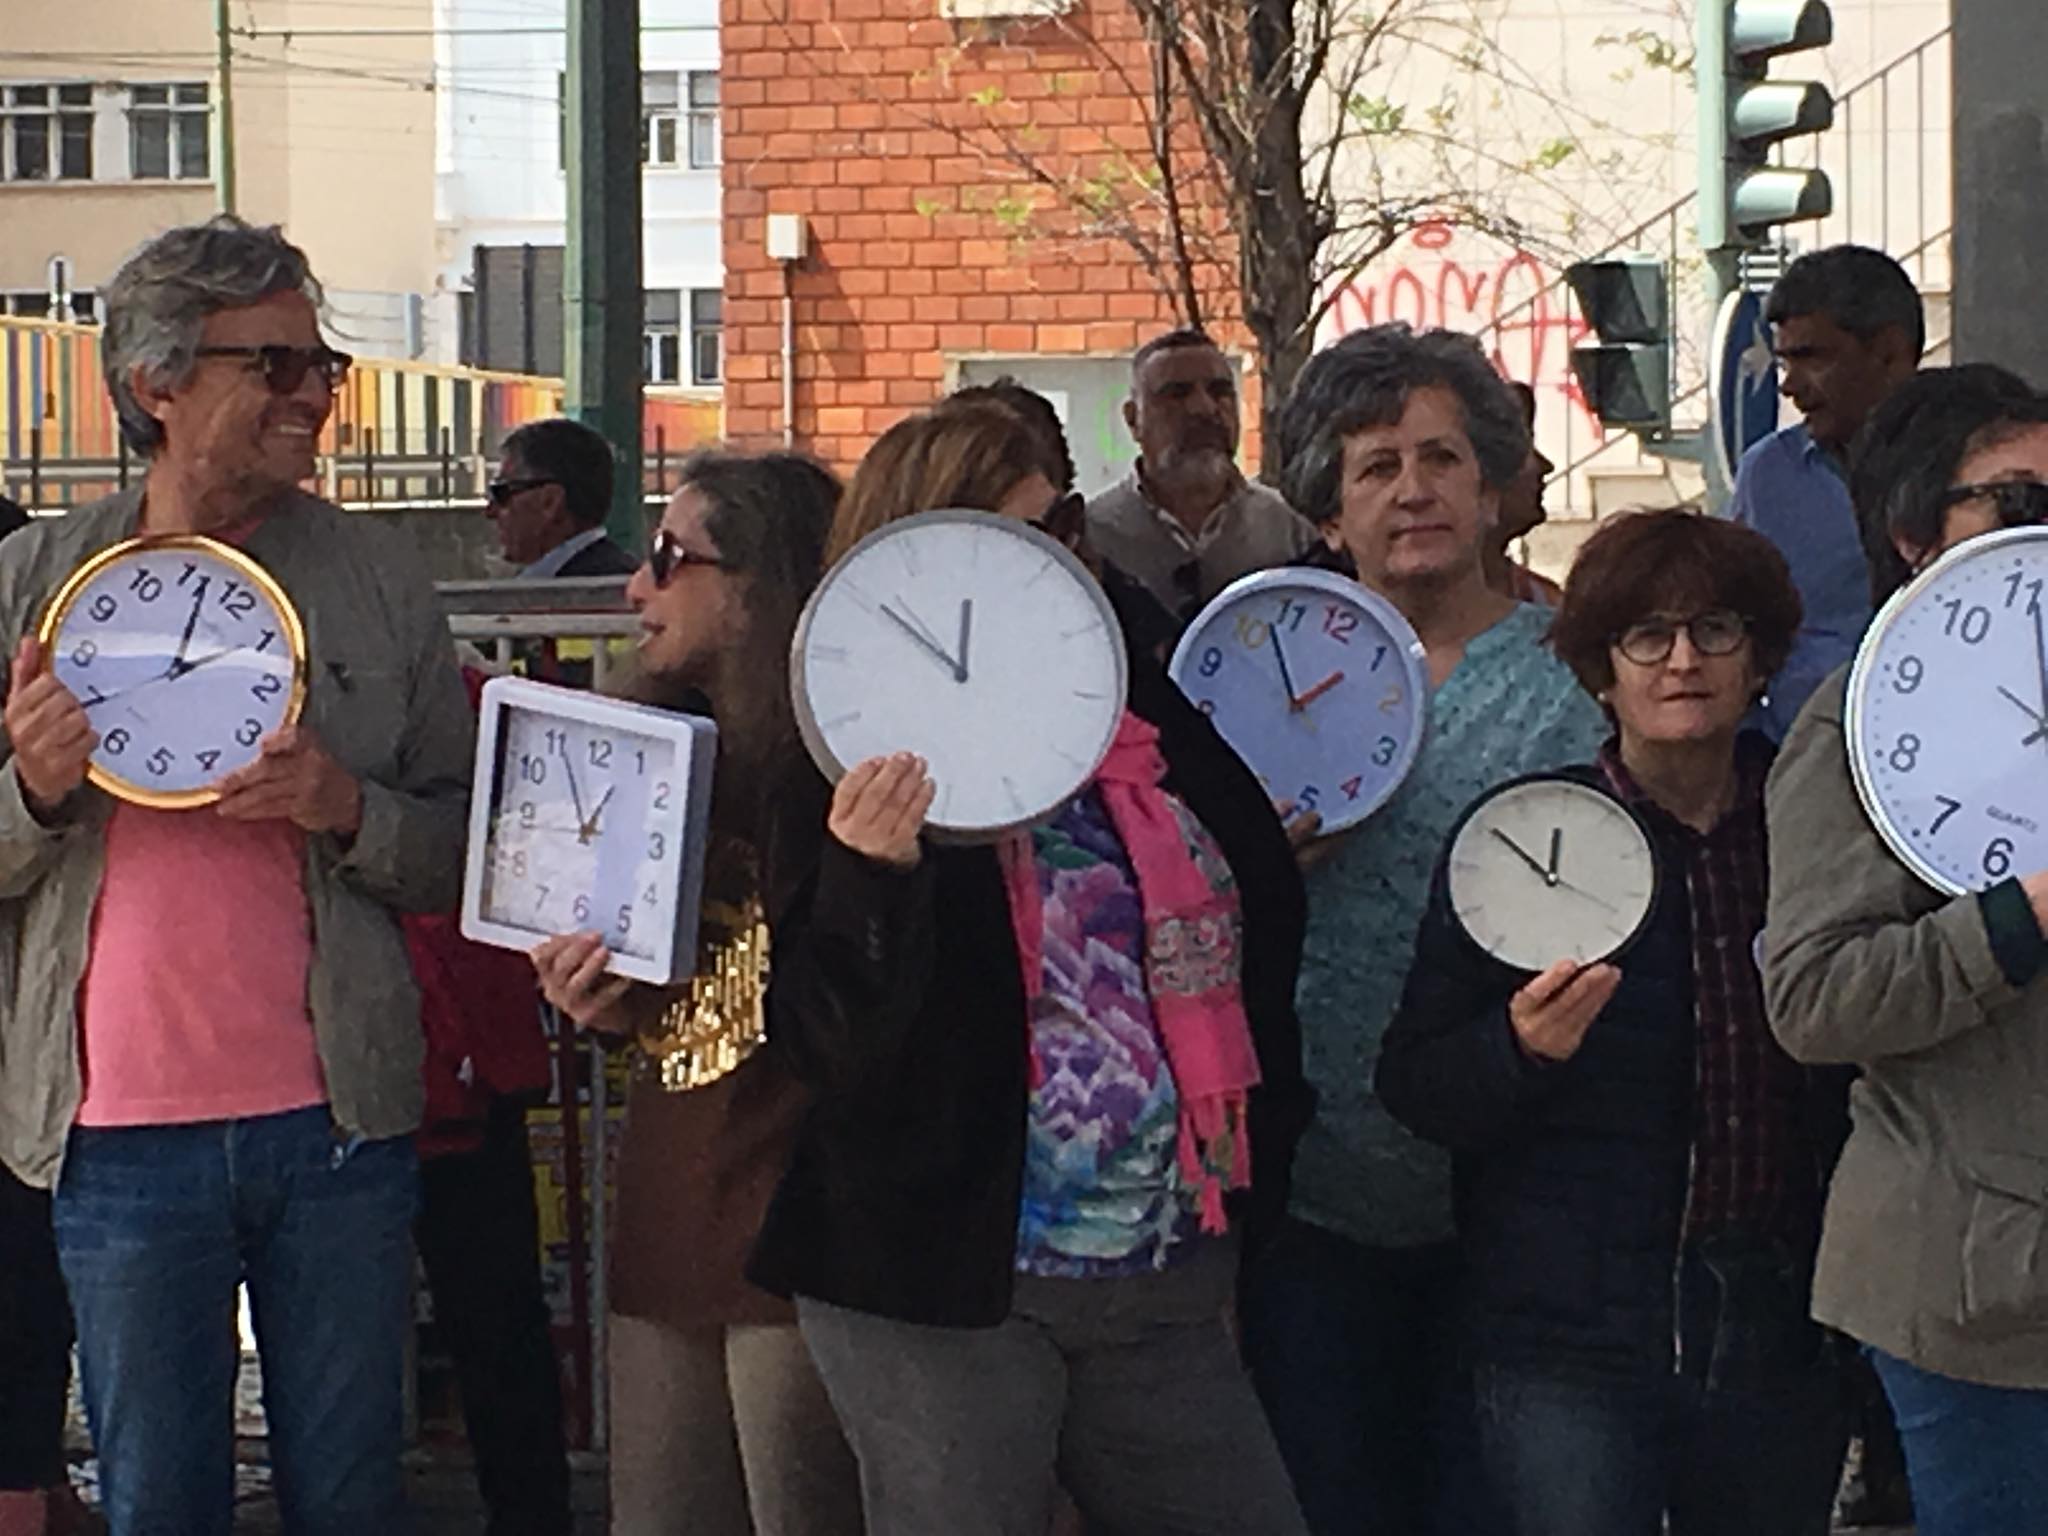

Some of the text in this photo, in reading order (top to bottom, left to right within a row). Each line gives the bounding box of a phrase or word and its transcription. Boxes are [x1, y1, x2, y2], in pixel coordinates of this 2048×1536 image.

[128, 567, 163, 602] 10
[176, 562, 212, 601] 11
[2003, 571, 2044, 616] 11
[88, 594, 118, 623] 9
[218, 580, 257, 621] 12
[1277, 597, 1307, 633] 11
[1233, 611, 1268, 650] 10
[1322, 604, 1359, 646] 12
[1943, 598, 1992, 644] 10
[70, 639, 98, 668] 8
[255, 629, 276, 653] 1
[1198, 646, 1222, 678] 9
[1371, 646, 1388, 672] 1
[251, 672, 282, 703] 2
[1892, 655, 1924, 694] 9
[81, 684, 105, 707] 7
[103, 728, 130, 756] 6
[234, 718, 263, 748] 3
[545, 728, 567, 757] 11
[146, 746, 176, 776] 5
[195, 749, 223, 772] 4
[588, 740, 613, 769] 12
[635, 750, 645, 776] 1
[1371, 735, 1397, 767] 3
[1888, 733, 1922, 773] 8
[520, 753, 546, 785] 10
[653, 782, 671, 811] 2
[1340, 775, 1364, 801] 4
[520, 801, 537, 830] 9
[1934, 794, 1962, 836] 7
[647, 832, 665, 861] 3
[1983, 838, 2015, 877] 6
[535, 884, 550, 911] 7
[572, 893, 590, 922] 6
[642, 881, 659, 909] 4
[616, 903, 633, 933] 5
